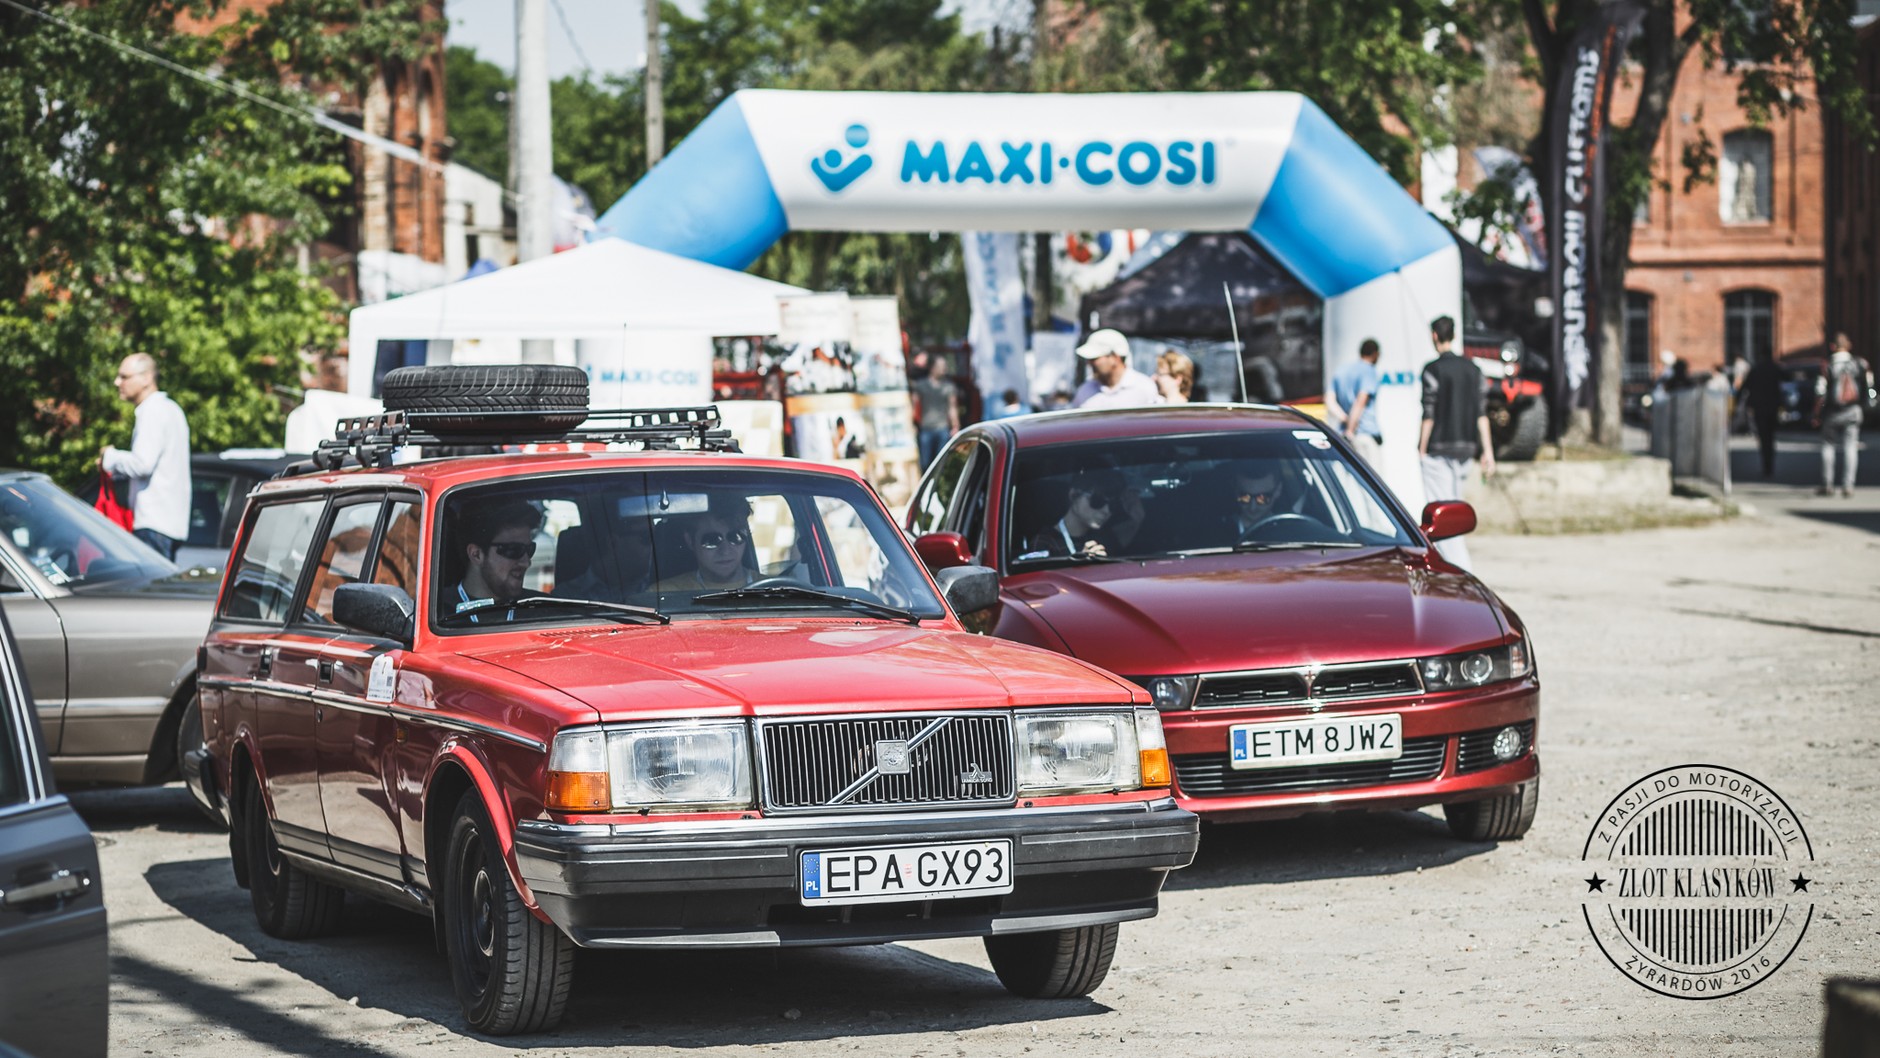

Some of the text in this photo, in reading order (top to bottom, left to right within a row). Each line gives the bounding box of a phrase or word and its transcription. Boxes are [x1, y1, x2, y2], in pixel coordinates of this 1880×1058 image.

[1252, 722, 1394, 758] ETM 8JW2
[1235, 749, 1246, 758] PL
[827, 847, 1004, 892] EPA GX93
[805, 881, 819, 892] PL
